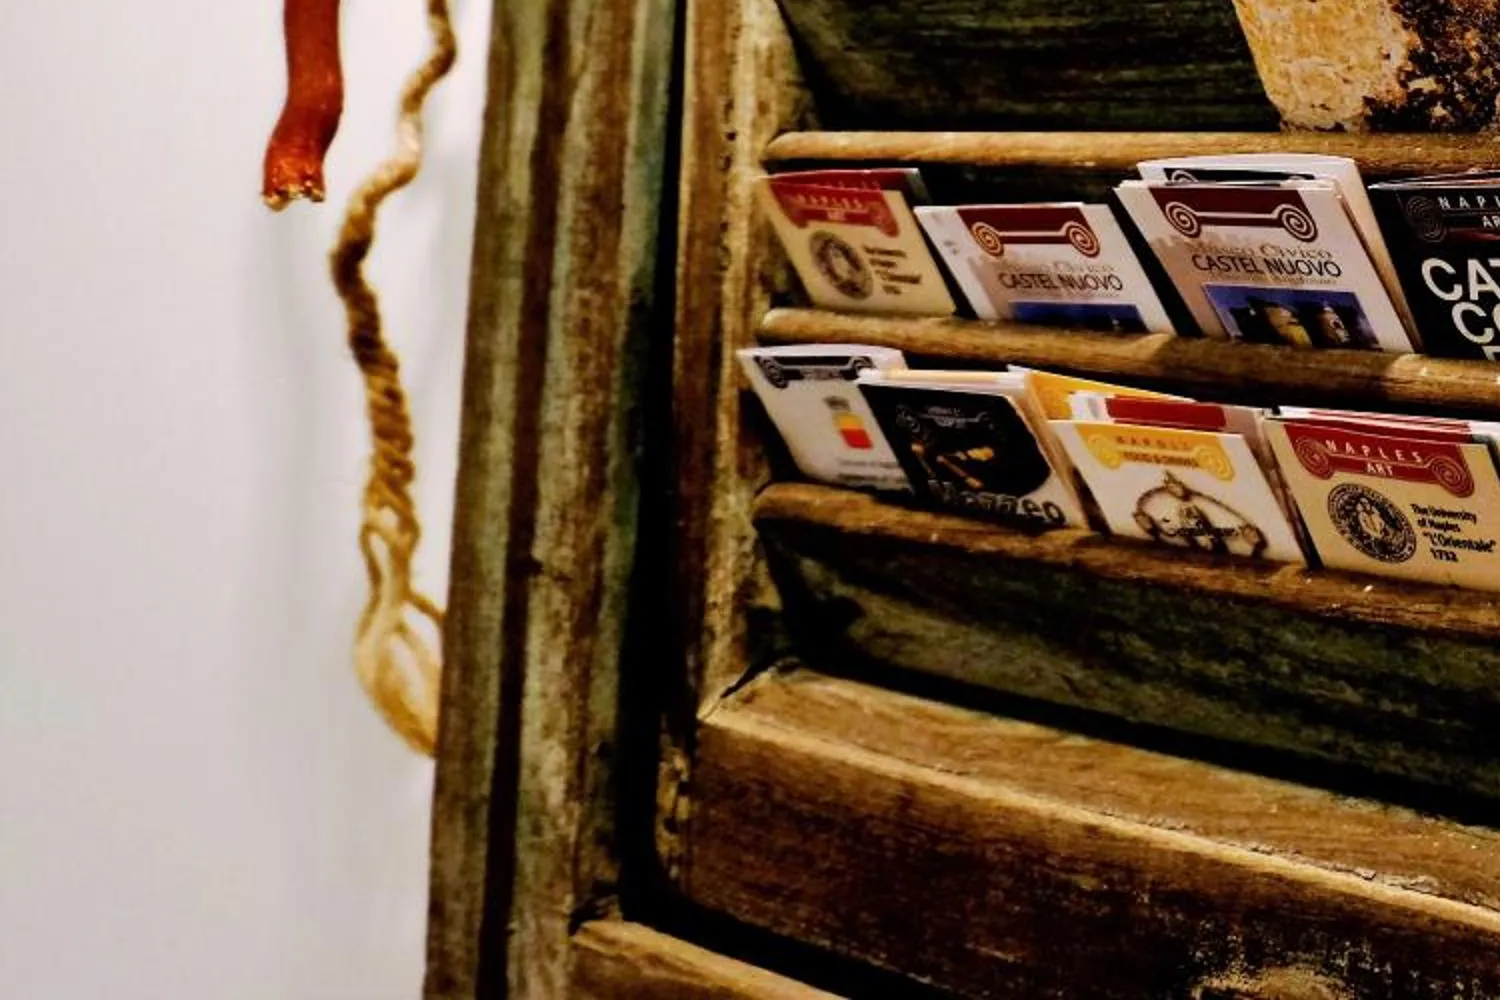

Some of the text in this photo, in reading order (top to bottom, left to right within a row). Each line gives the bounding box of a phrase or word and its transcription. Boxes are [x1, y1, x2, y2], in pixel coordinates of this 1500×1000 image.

[1192, 255, 1264, 275] CASTEL
[1266, 258, 1342, 278] NUOVO
[998, 272, 1123, 291] CASTEL NUOVO
[1325, 439, 1424, 463] NAPLES
[1366, 463, 1394, 476] ART
